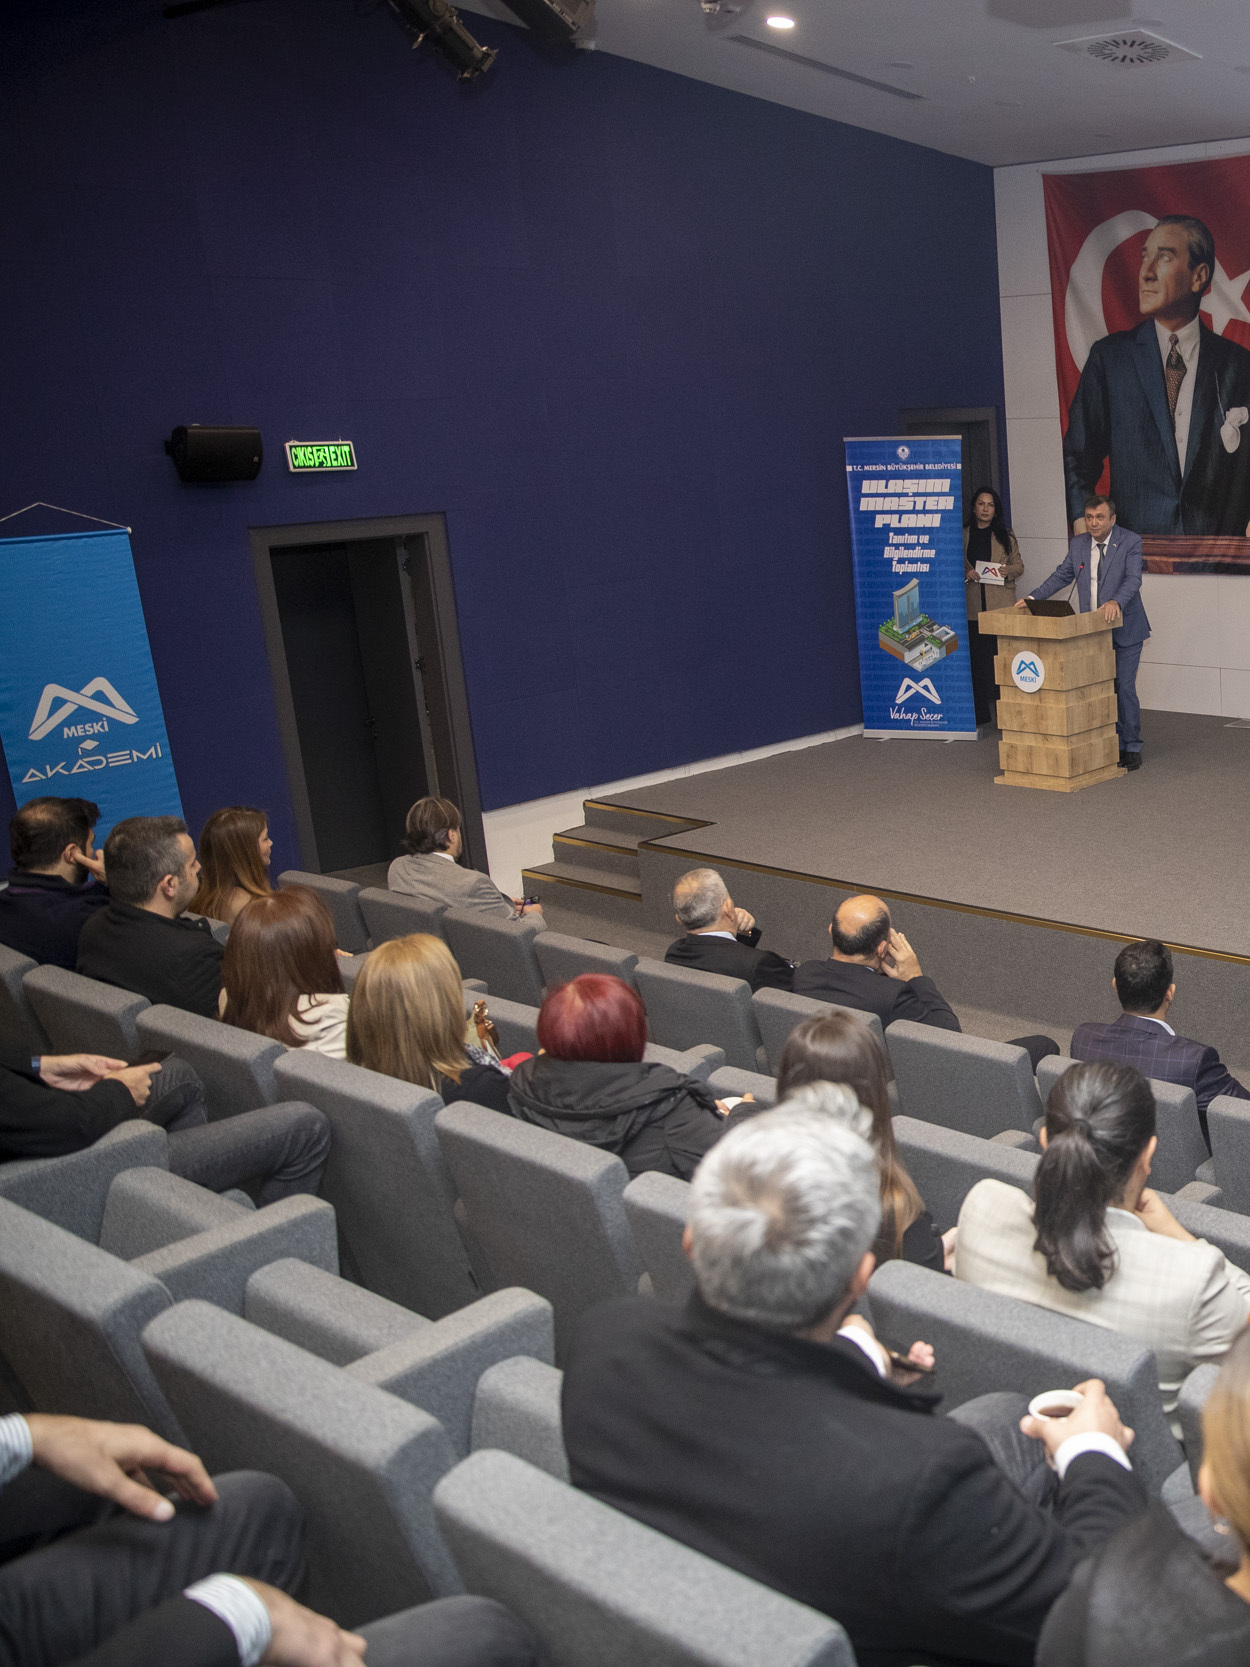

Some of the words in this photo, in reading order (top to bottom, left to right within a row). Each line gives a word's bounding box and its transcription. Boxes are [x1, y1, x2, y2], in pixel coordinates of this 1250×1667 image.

[329, 445, 351, 467] EXIT
[863, 463, 886, 471] MERSİN
[887, 463, 924, 472] BÜYÜKŞEHİR
[925, 462, 956, 470] BELEDİYESİ
[861, 478, 951, 496] ULAŞIM
[859, 496, 955, 511] MASTER
[874, 513, 942, 528] PLANI
[888, 532, 918, 544] Tanıtım
[918, 535, 930, 544] ve
[883, 546, 936, 561] Bilgilendirme
[892, 560, 930, 575] Toplantısı
[889, 705, 918, 726] Vahap
[63, 717, 109, 739] MESKİ
[21, 742, 163, 783] AKADEMİ
